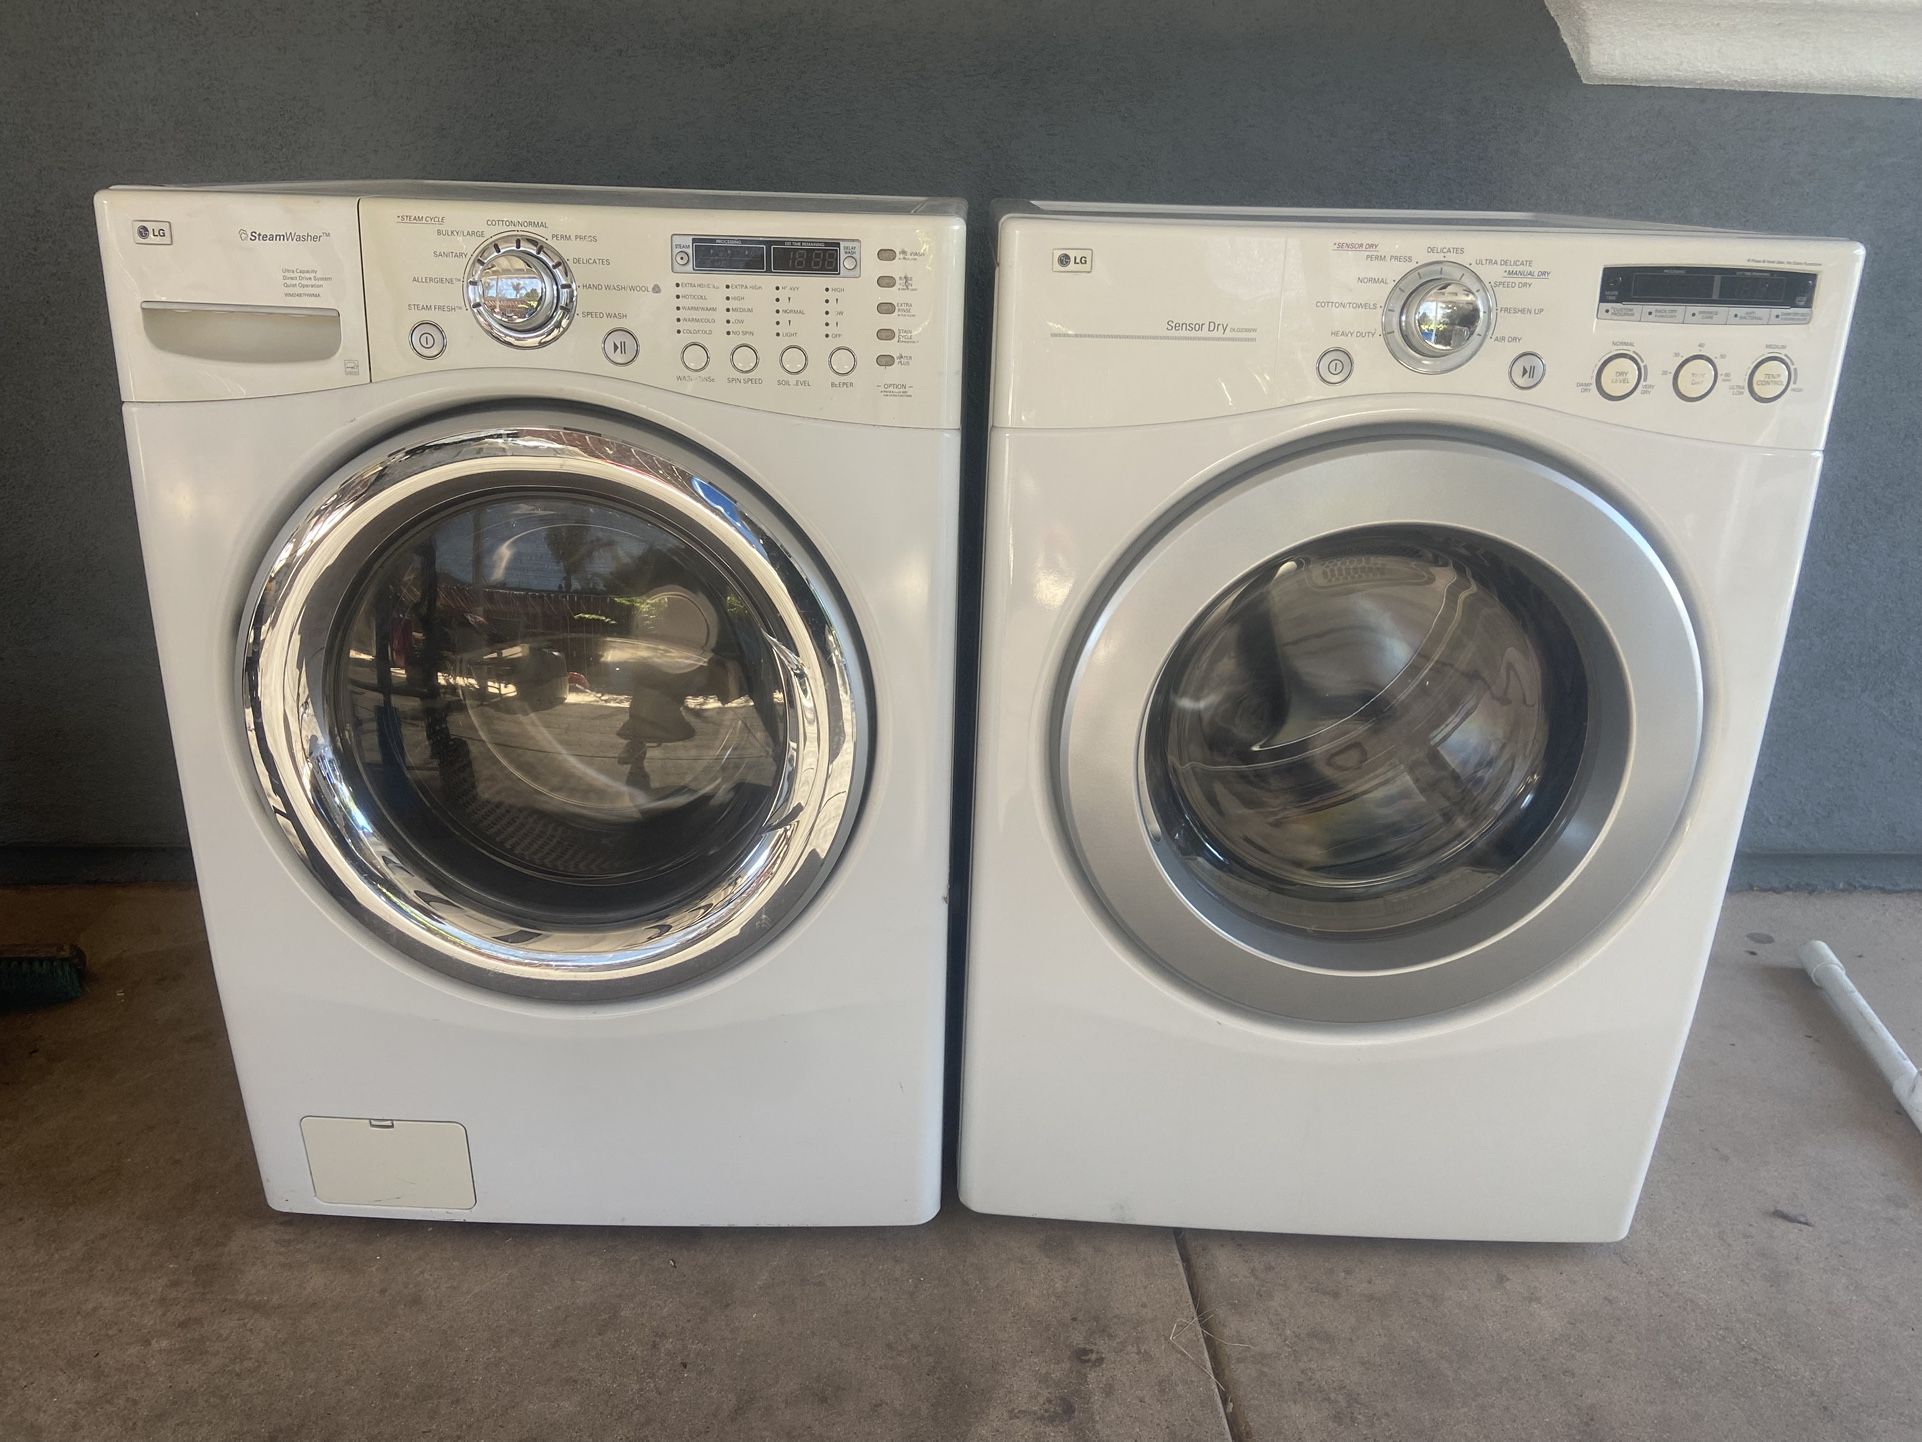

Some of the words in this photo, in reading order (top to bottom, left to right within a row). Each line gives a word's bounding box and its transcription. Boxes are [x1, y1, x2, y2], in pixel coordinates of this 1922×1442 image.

[486, 219, 549, 229] COTTON/NORMAL
[152, 228, 166, 238] LG
[436, 229, 485, 238] BULKY/LARGE
[551, 233, 572, 241] PERM.
[574, 235, 598, 243] PRESS
[433, 250, 468, 259] SANITARY
[1426, 246, 1465, 255] DELICATES
[572, 257, 611, 266] DELICATES
[1073, 255, 1088, 265] LG
[1365, 254, 1388, 262] PERM.
[1389, 255, 1413, 263] PRESS
[1475, 258, 1498, 266] ULTRA
[1499, 259, 1533, 267] DELICATE
[1537, 270, 1552, 278] DRY
[1357, 276, 1389, 285] NORMAL
[1493, 280, 1516, 289] SPEED
[582, 283, 603, 291] HAND
[604, 284, 650, 293] WASH/WOOL
[407, 303, 433, 311] STEAM
[1315, 300, 1378, 310] COTTON/TOWELS
[1499, 306, 1532, 315] FRESHEN
[581, 311, 604, 319] SPEED
[605, 312, 628, 320] WASH
[1166, 320, 1205, 332] Sensor
[1207, 320, 1229, 335] Dry
[1330, 330, 1354, 338] HEAVY
[742, 377, 763, 385] SPEED
